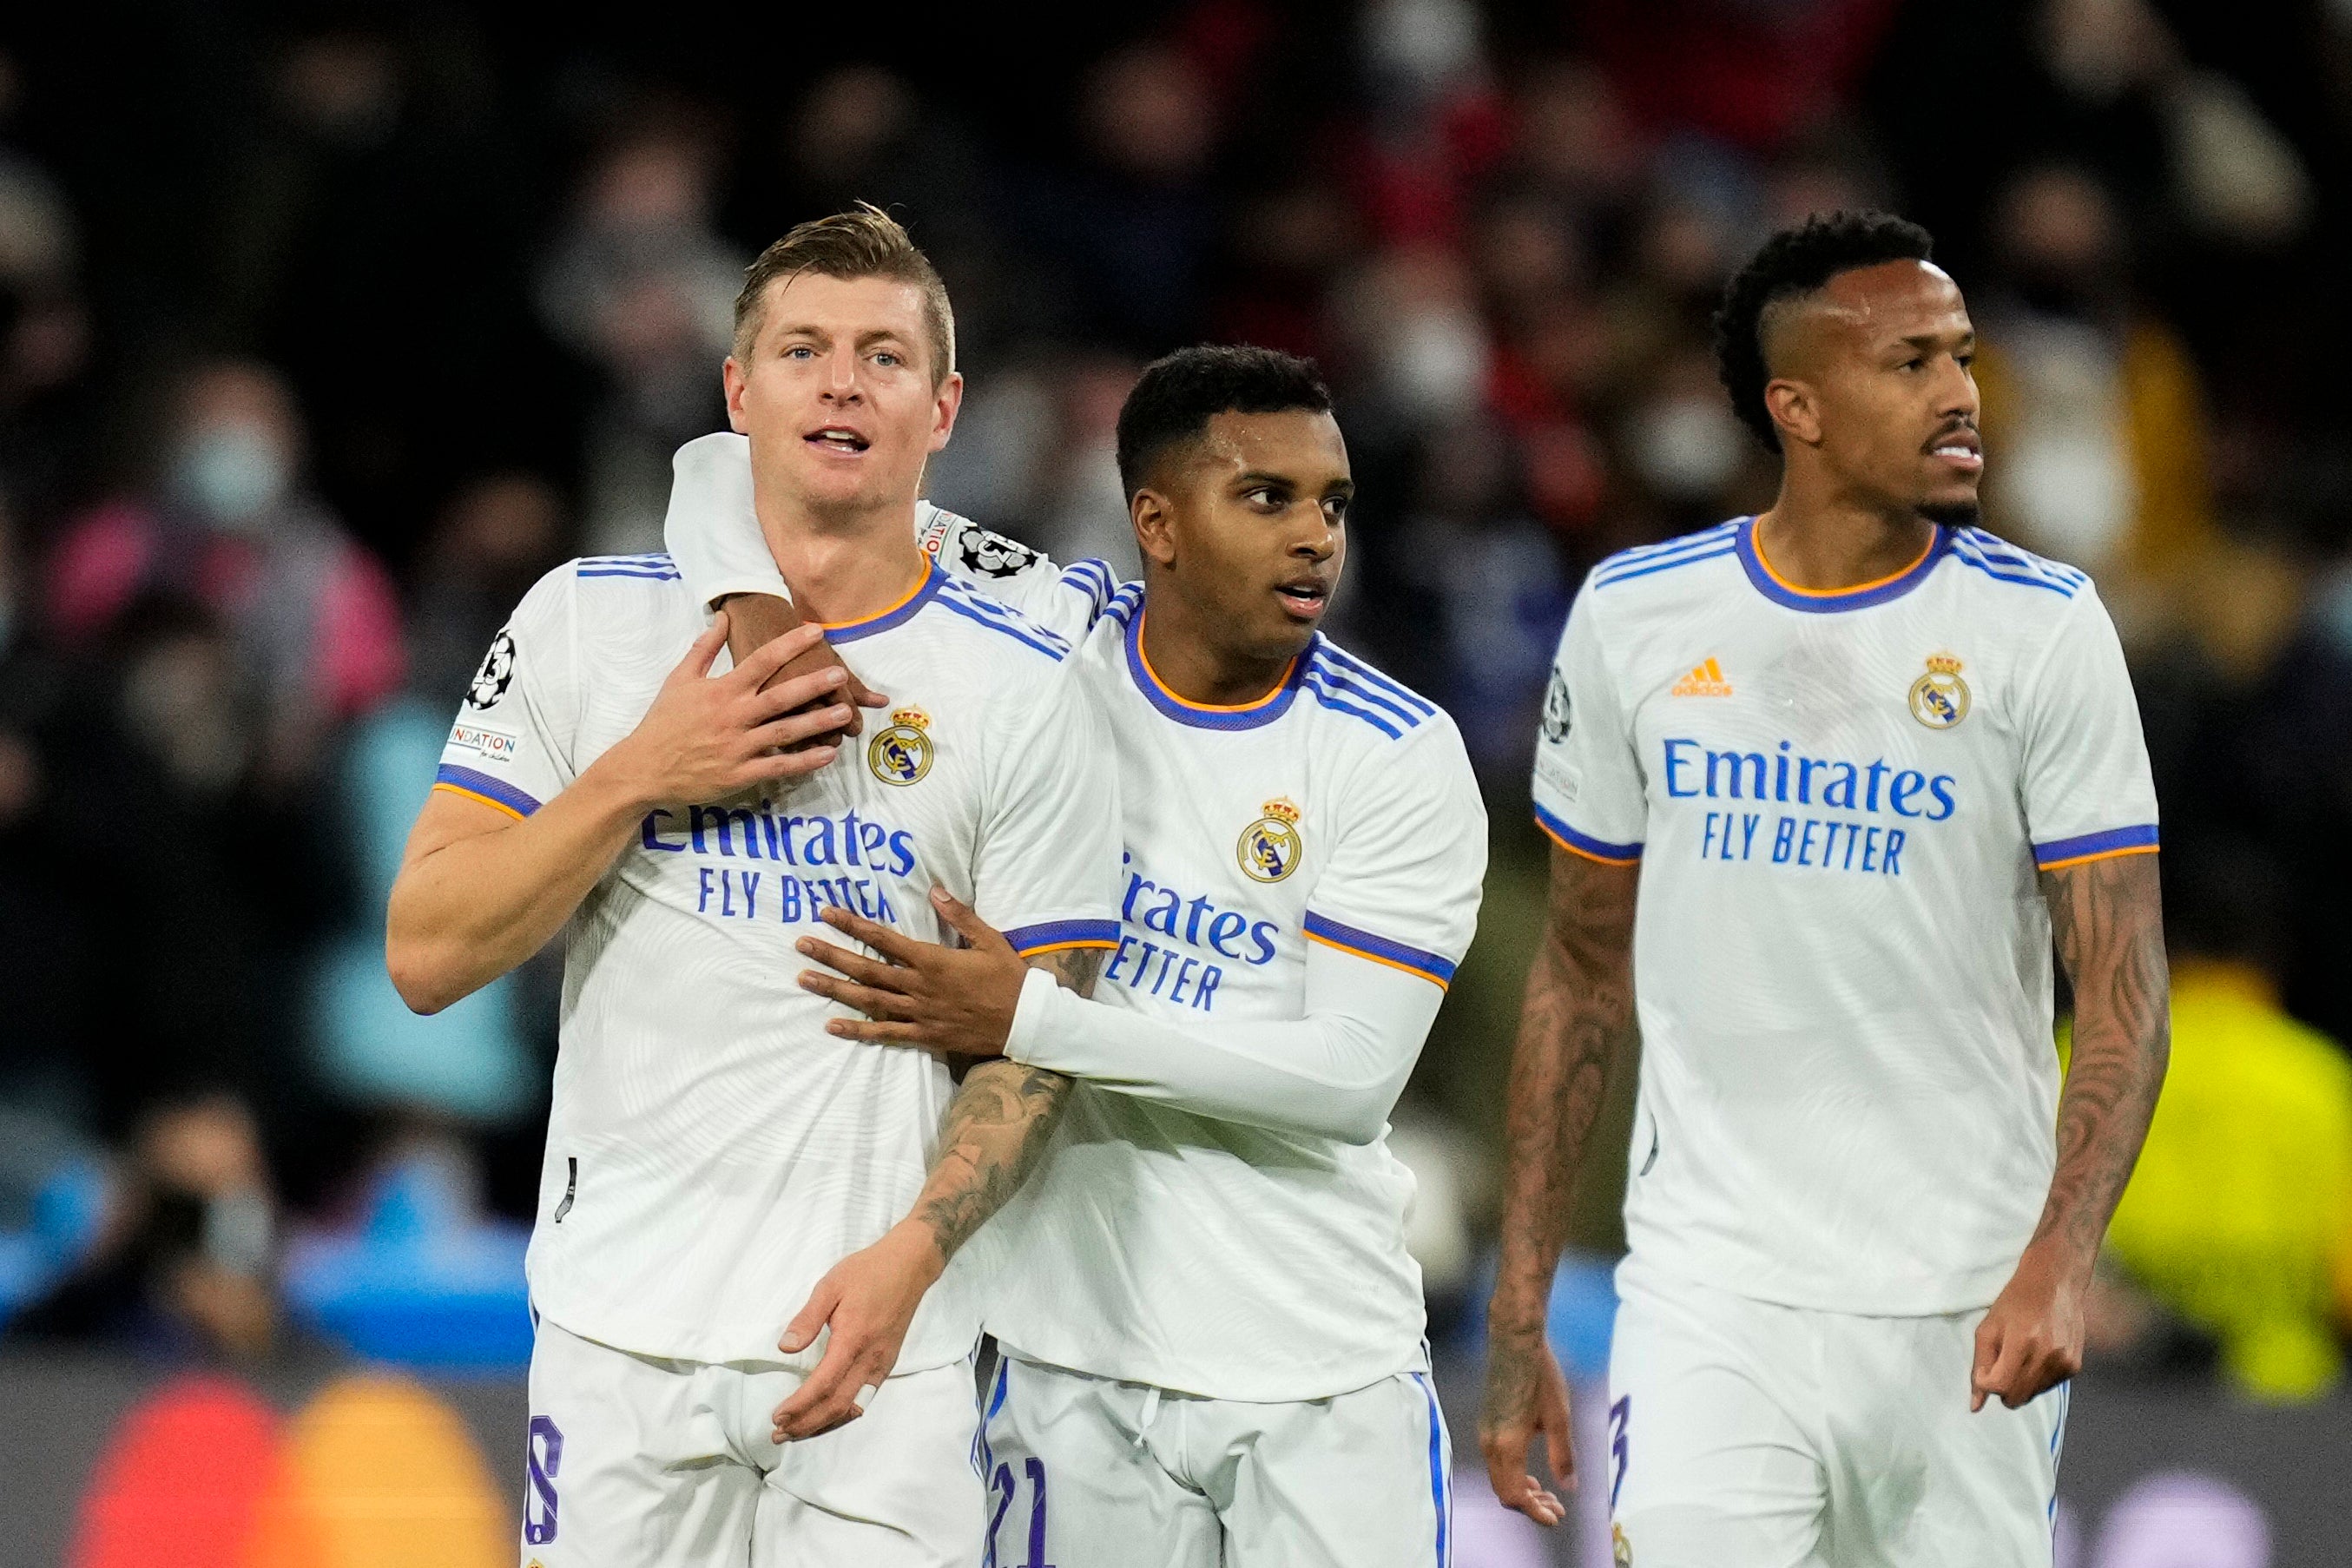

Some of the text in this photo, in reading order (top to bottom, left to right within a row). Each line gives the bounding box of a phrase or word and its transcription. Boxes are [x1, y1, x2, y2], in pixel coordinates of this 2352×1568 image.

[1671, 683, 1733, 696] adidas
[1663, 738, 1957, 821] Emirates
[641, 798, 916, 877] Emirates
[1703, 812, 1907, 876] FLY BETTER
[698, 868, 761, 919] FLY
[1104, 935, 1222, 1011] ETTER
[989, 1457, 1056, 1568] 21
